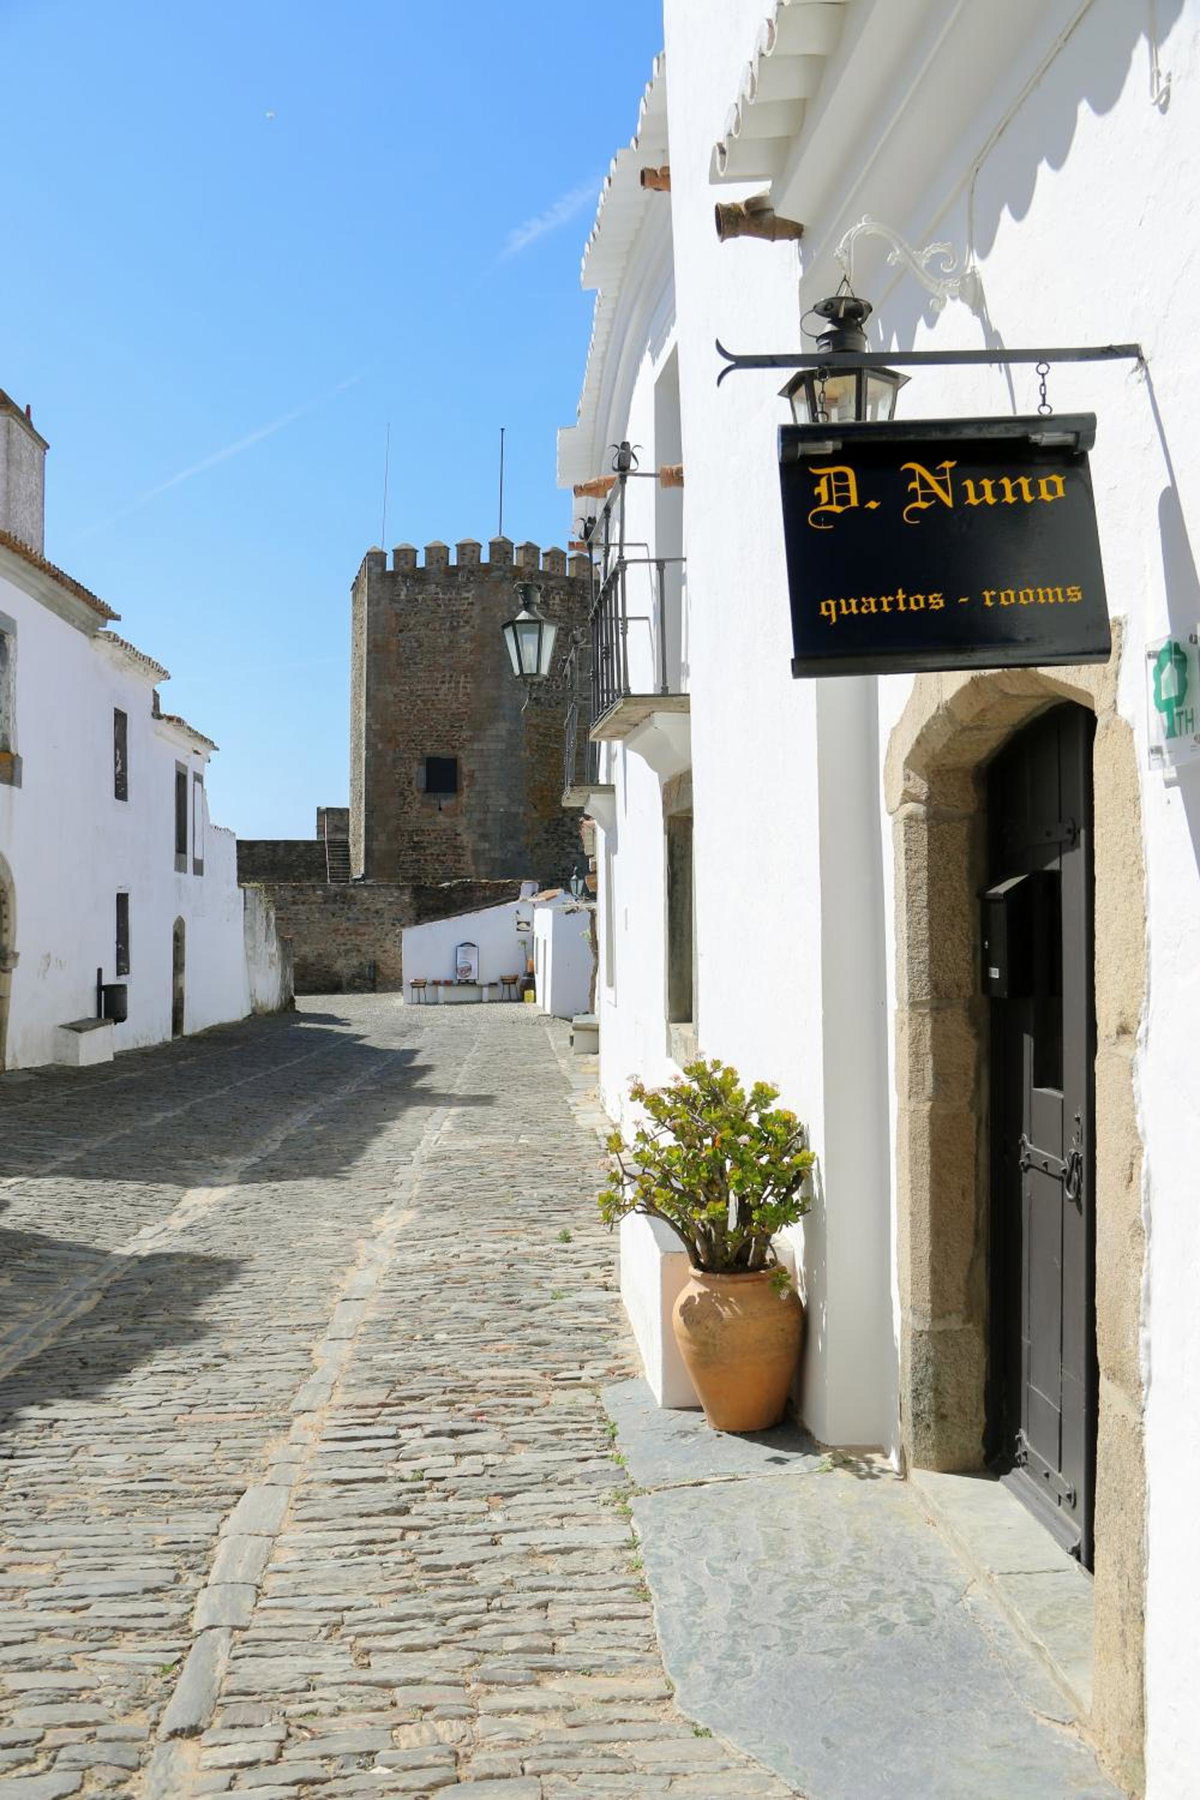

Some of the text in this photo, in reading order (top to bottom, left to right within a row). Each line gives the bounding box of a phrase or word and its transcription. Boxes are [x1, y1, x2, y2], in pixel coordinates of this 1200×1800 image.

[808, 460, 1066, 529] D. Nuno
[819, 587, 945, 625] quartos
[982, 584, 1083, 608] rooms
[1175, 707, 1195, 737] TH
